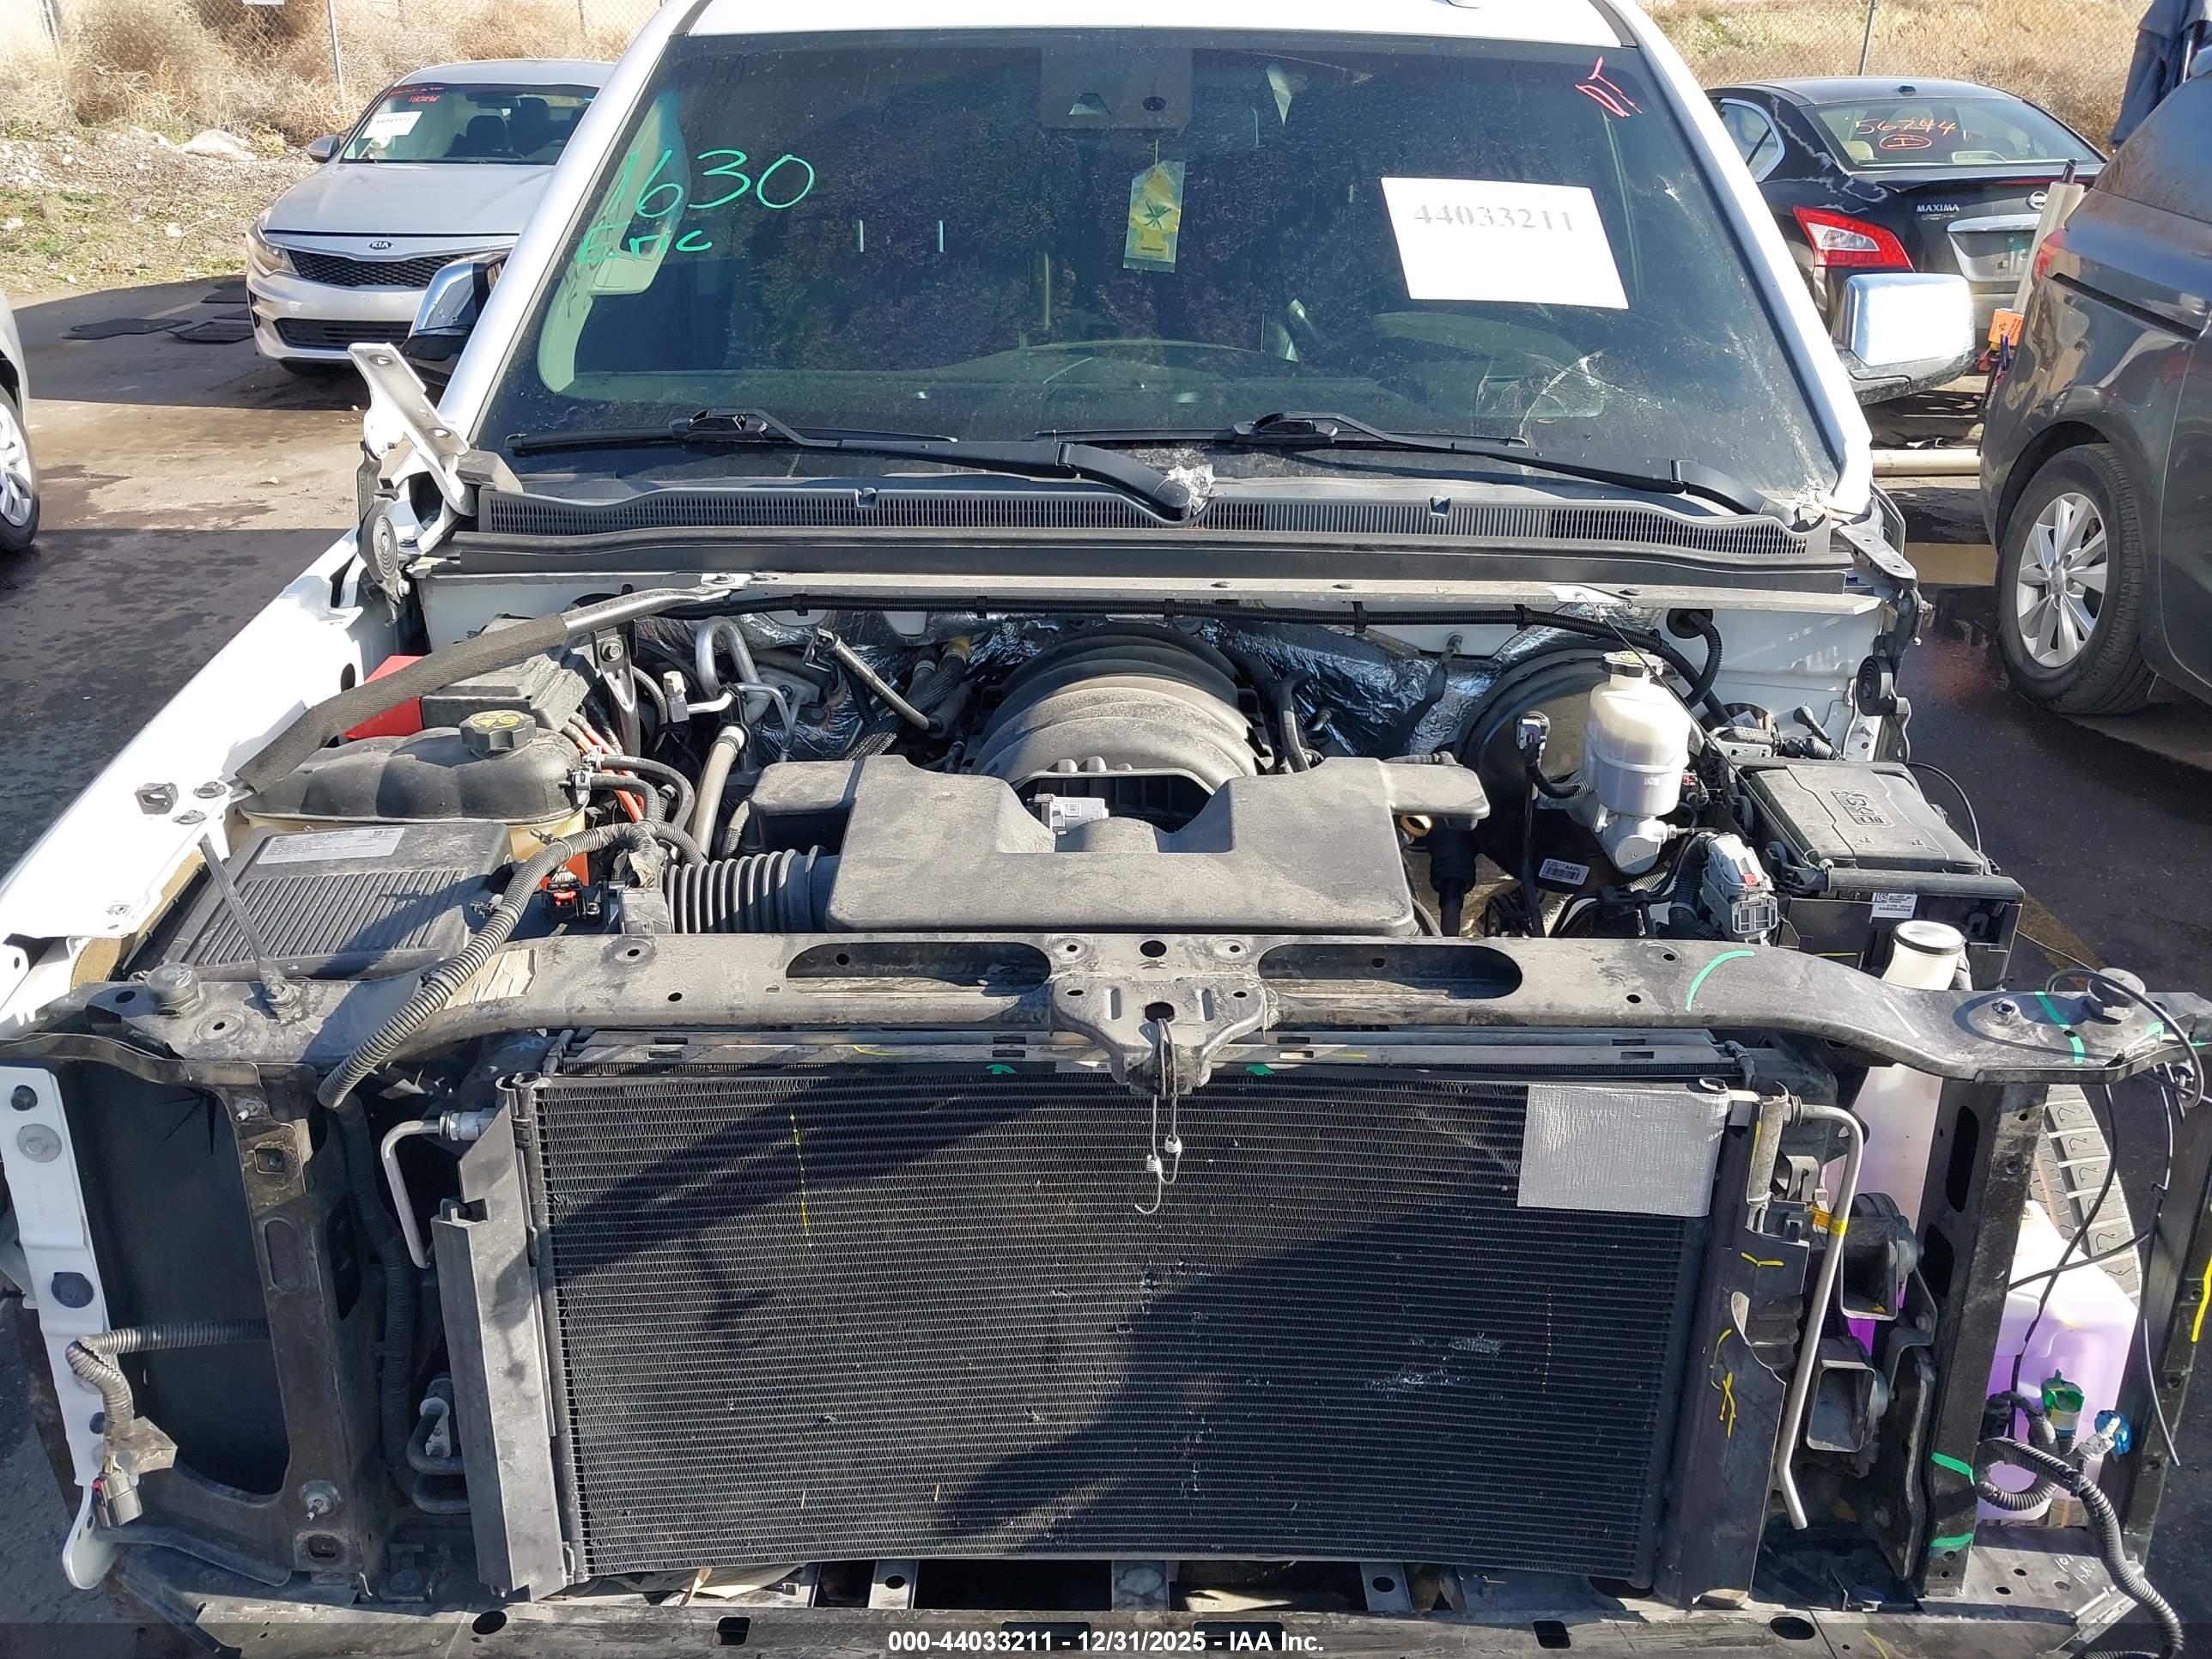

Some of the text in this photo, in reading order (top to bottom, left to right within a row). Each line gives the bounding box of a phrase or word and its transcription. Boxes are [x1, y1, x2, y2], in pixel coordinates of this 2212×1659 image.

[611, 149, 815, 218] 1630
[1413, 204, 1574, 232] 44033211
[1916, 204, 1960, 213] MAXIMA
